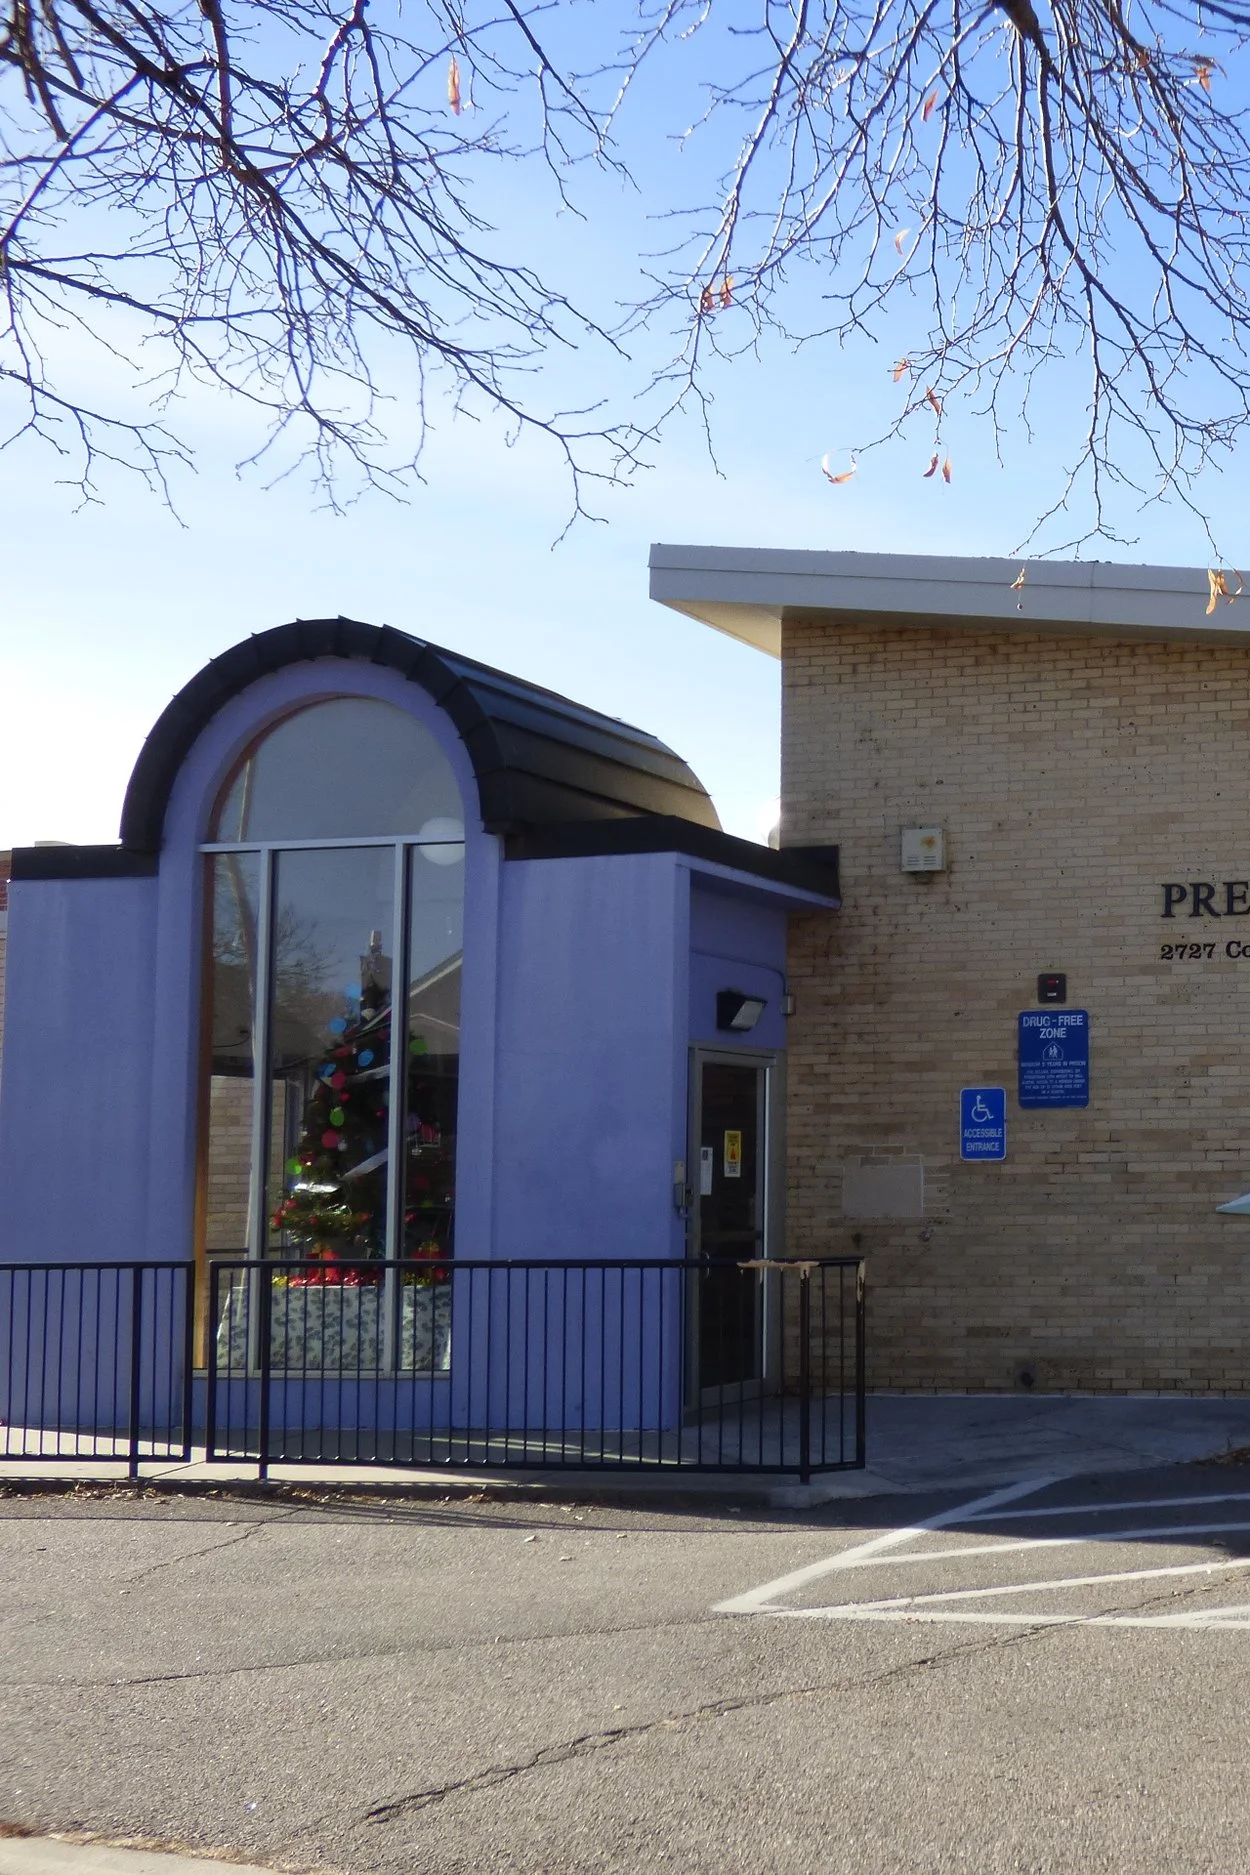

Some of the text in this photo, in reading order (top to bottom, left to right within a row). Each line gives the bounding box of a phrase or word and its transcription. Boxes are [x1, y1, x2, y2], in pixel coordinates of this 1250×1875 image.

[1160, 943, 1215, 960] 2727
[1039, 1027, 1067, 1039] ZONE
[963, 1128, 1003, 1138] ACCESSIBLE
[966, 1142, 1000, 1152] ENTRANCE
